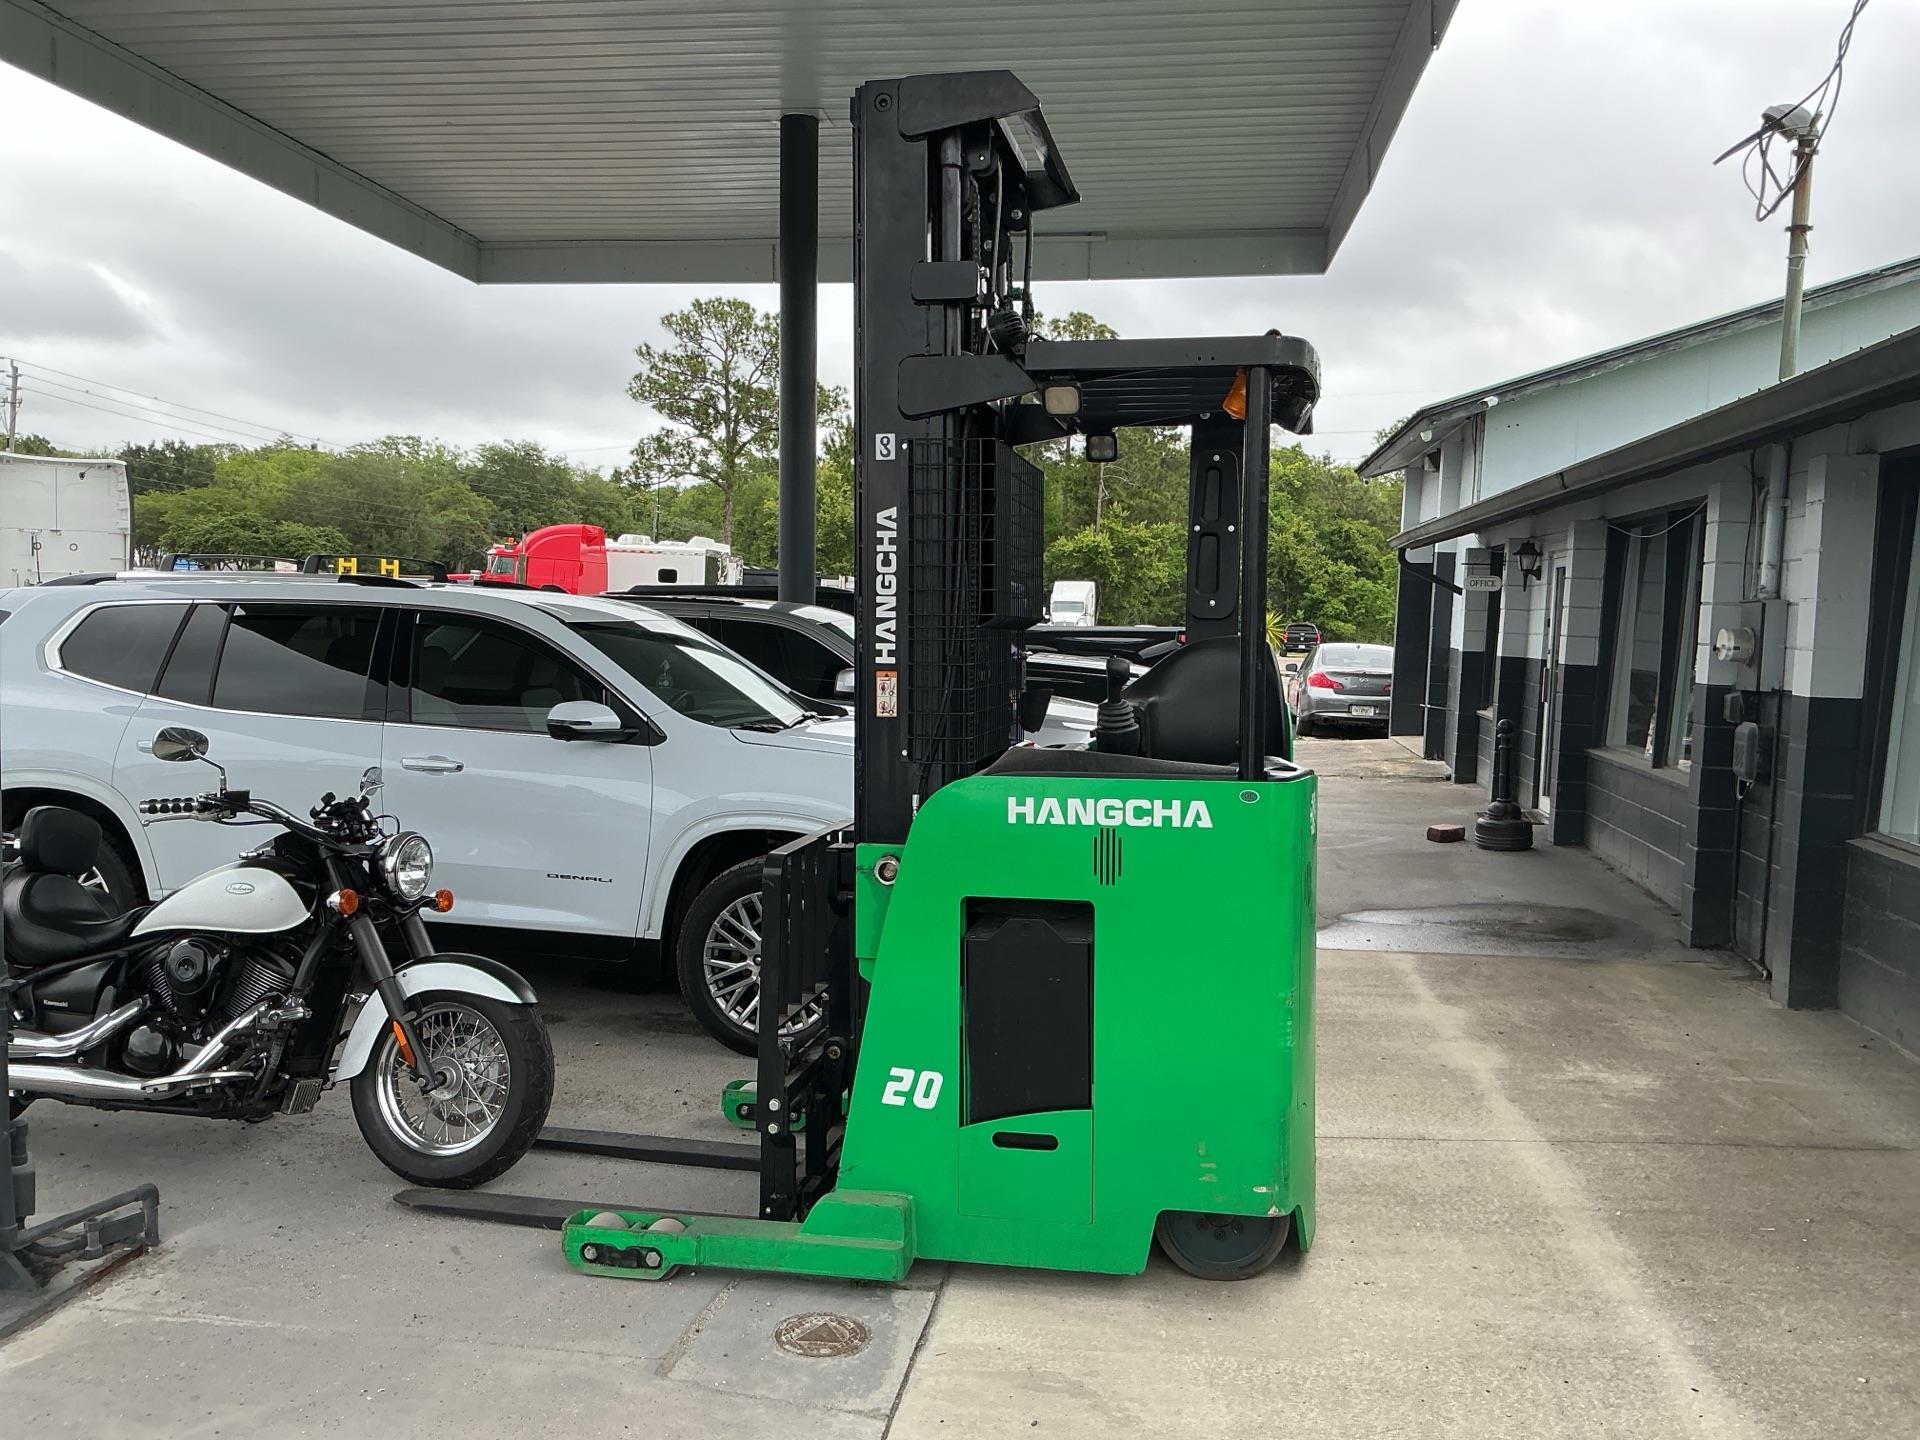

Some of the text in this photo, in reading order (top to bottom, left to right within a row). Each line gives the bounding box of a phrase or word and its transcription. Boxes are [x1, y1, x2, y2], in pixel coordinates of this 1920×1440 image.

[875, 506, 898, 665] HANGCHA
[1007, 796, 1214, 829] HANGCHA
[547, 874, 612, 883] DENALI
[881, 1066, 944, 1110] 20
